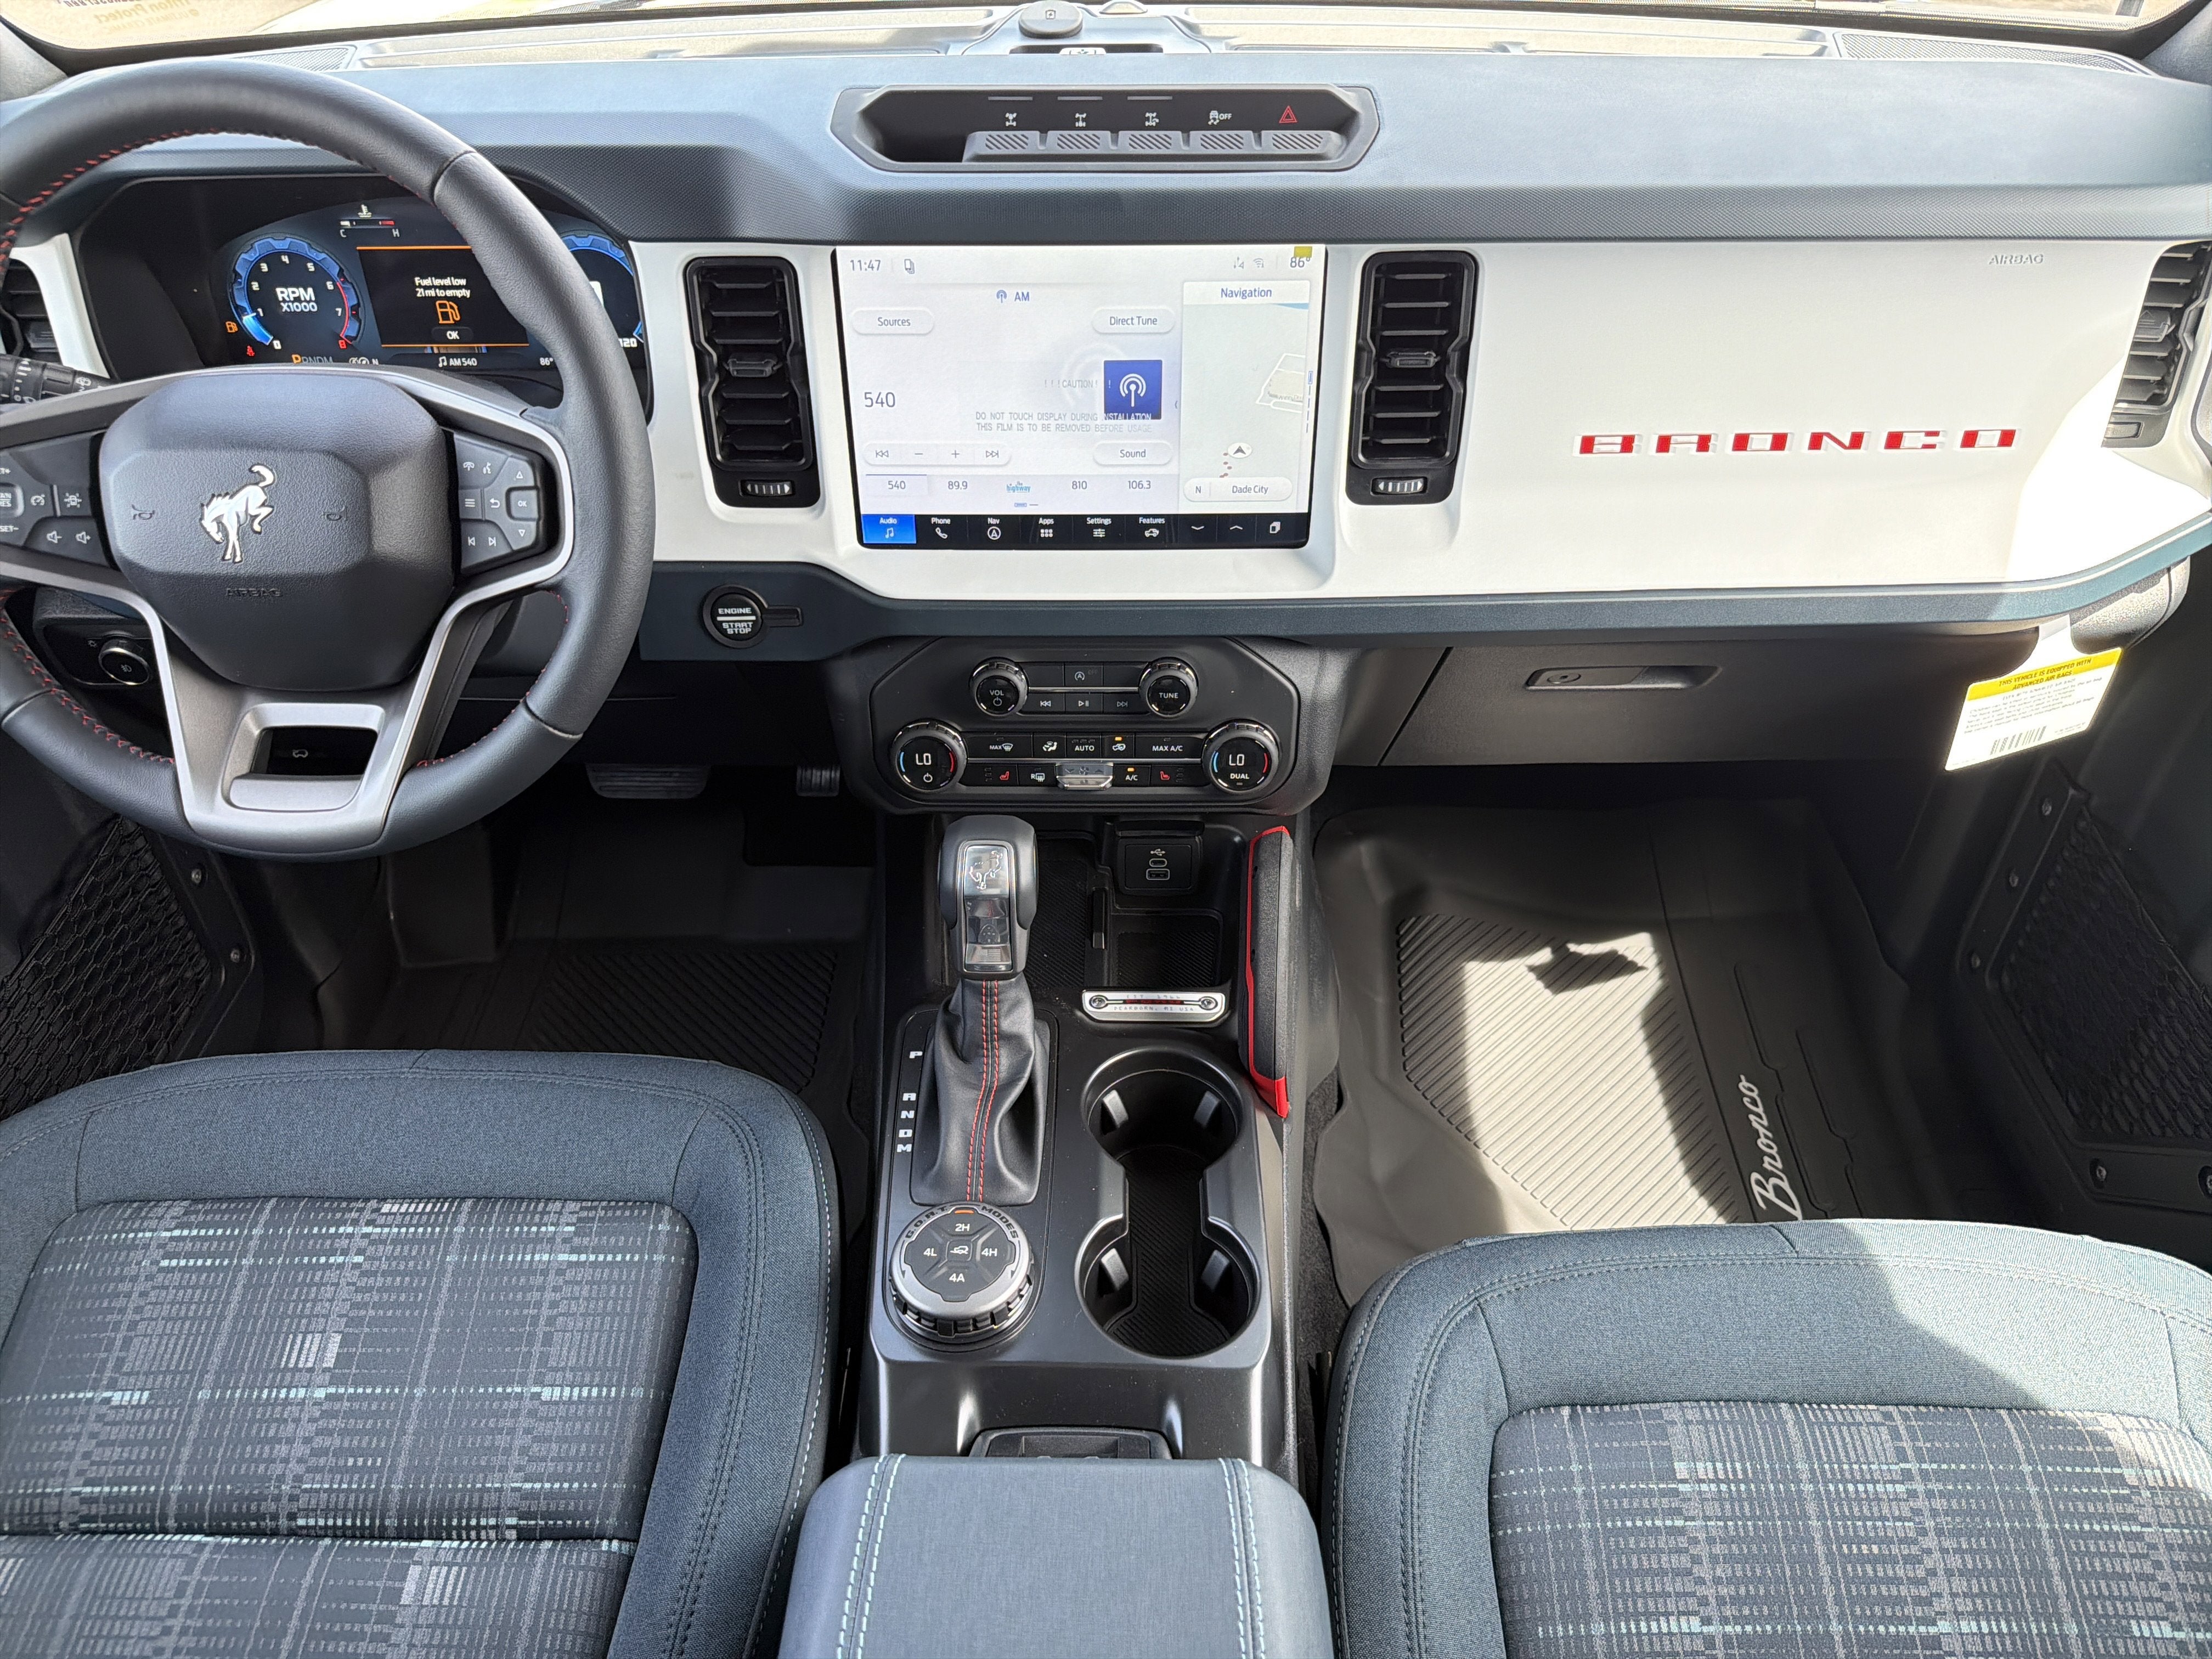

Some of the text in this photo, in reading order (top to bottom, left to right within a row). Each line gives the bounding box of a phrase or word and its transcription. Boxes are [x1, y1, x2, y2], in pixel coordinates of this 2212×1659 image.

[281, 255, 289, 264] 4
[1989, 254, 2044, 265] AIRBAG
[260, 263, 268, 272] 3
[307, 263, 315, 272] 5
[850, 259, 881, 272] 11:47
[251, 281, 259, 291] 2
[326, 281, 334, 290] 6
[415, 276, 466, 286] Fuel level low
[275, 287, 315, 301] RPM
[416, 288, 471, 298] 21 mi to empty
[1014, 291, 1030, 302] AM
[1221, 287, 1272, 300] Navigation
[280, 302, 318, 312] X1000
[257, 308, 264, 317] 1
[877, 317, 911, 328] Sources
[1109, 315, 1158, 326] Direct Tune
[446, 330, 460, 340] OK
[449, 358, 477, 366] AM 540
[864, 392, 896, 408] 540
[975, 412, 986, 420] DO
[990, 412, 1005, 421] NOT
[1009, 413, 1033, 421] TOUCH
[1037, 413, 1067, 421] DISPLAY
[1071, 413, 1098, 421] DURING
[977, 422, 1152, 432] THIS FILM IS TO BE REMOVED BEFORE USAGE
[1577, 428, 2019, 455] BRONCO
[1119, 449, 1146, 458] Sound
[887, 481, 906, 489] 540
[947, 481, 968, 490] 89.9
[1071, 481, 1087, 489] 810
[1128, 481, 1152, 489] 106.3
[1232, 485, 1268, 495] Dade City
[1039, 517, 1054, 526] Apps
[1086, 517, 1111, 526] Settings
[916, 753, 932, 766] LO
[1229, 754, 1245, 766] LO
[909, 1051, 923, 1059] P
[900, 1110, 915, 1119] N
[896, 1143, 913, 1153] M
[1737, 1074, 1803, 1221] Bronco
[981, 1205, 1019, 1239] MODES
[955, 1223, 970, 1232] 2H
[923, 1248, 938, 1257] 4L
[981, 1248, 998, 1257] 4H
[949, 1273, 966, 1283] 4A
